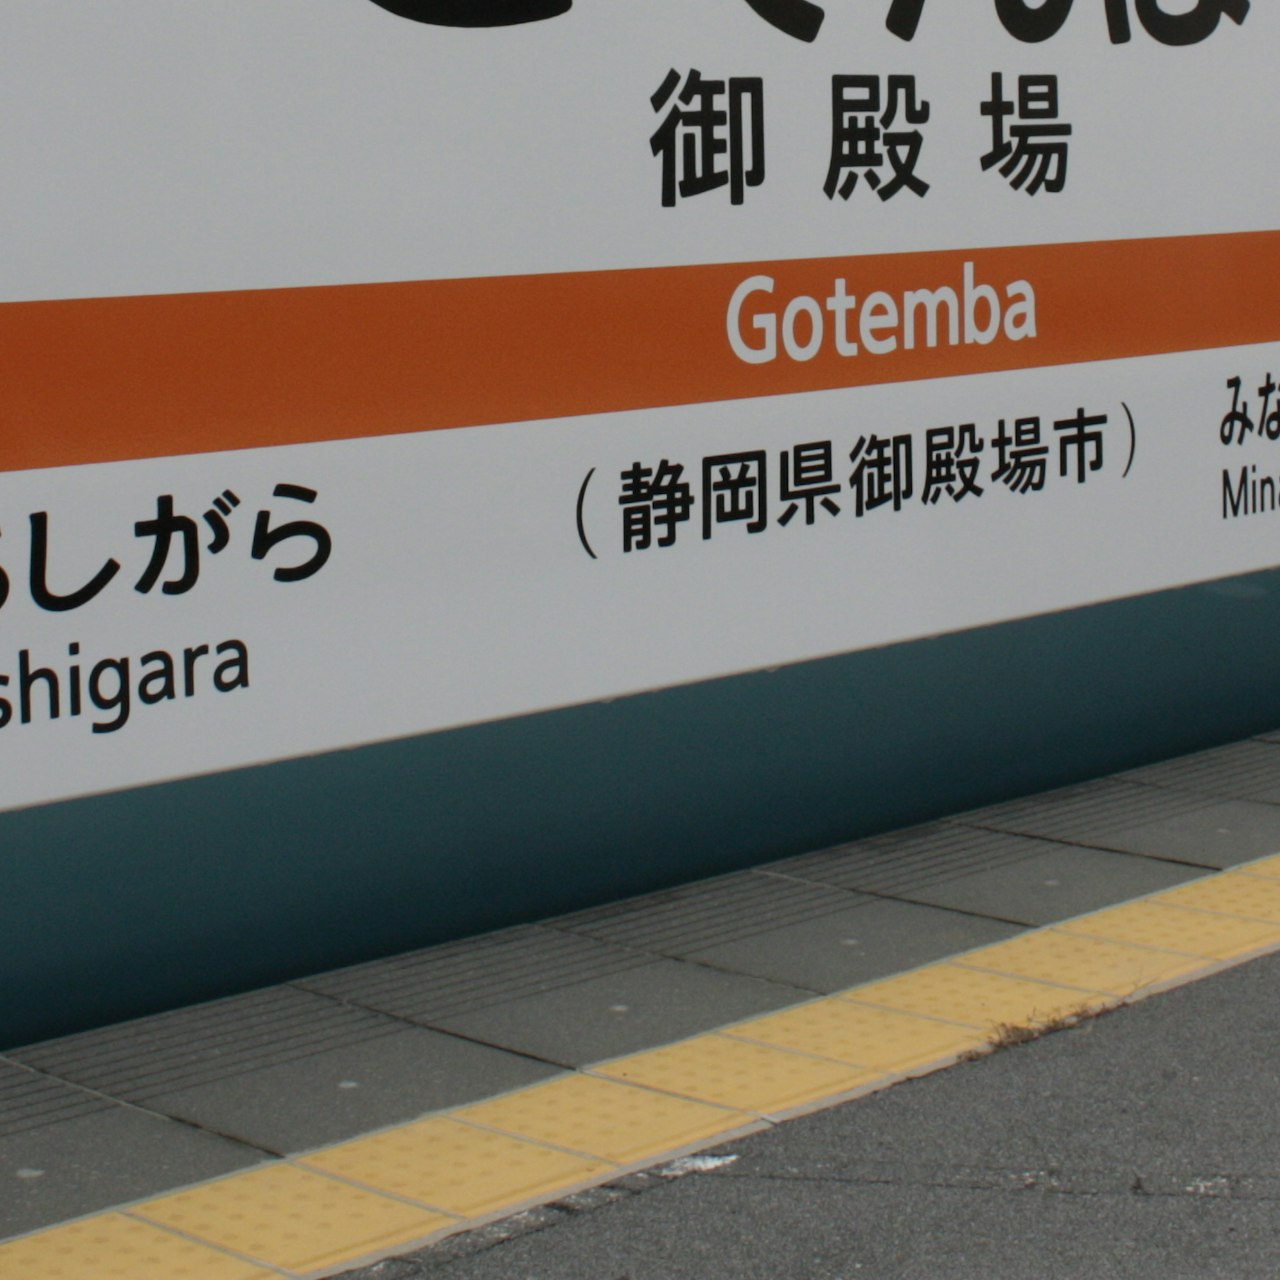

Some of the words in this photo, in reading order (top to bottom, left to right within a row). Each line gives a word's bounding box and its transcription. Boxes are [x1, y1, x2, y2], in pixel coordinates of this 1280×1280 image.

[649, 67, 1073, 208] 御殿場
[725, 260, 1038, 366] Gotemba
